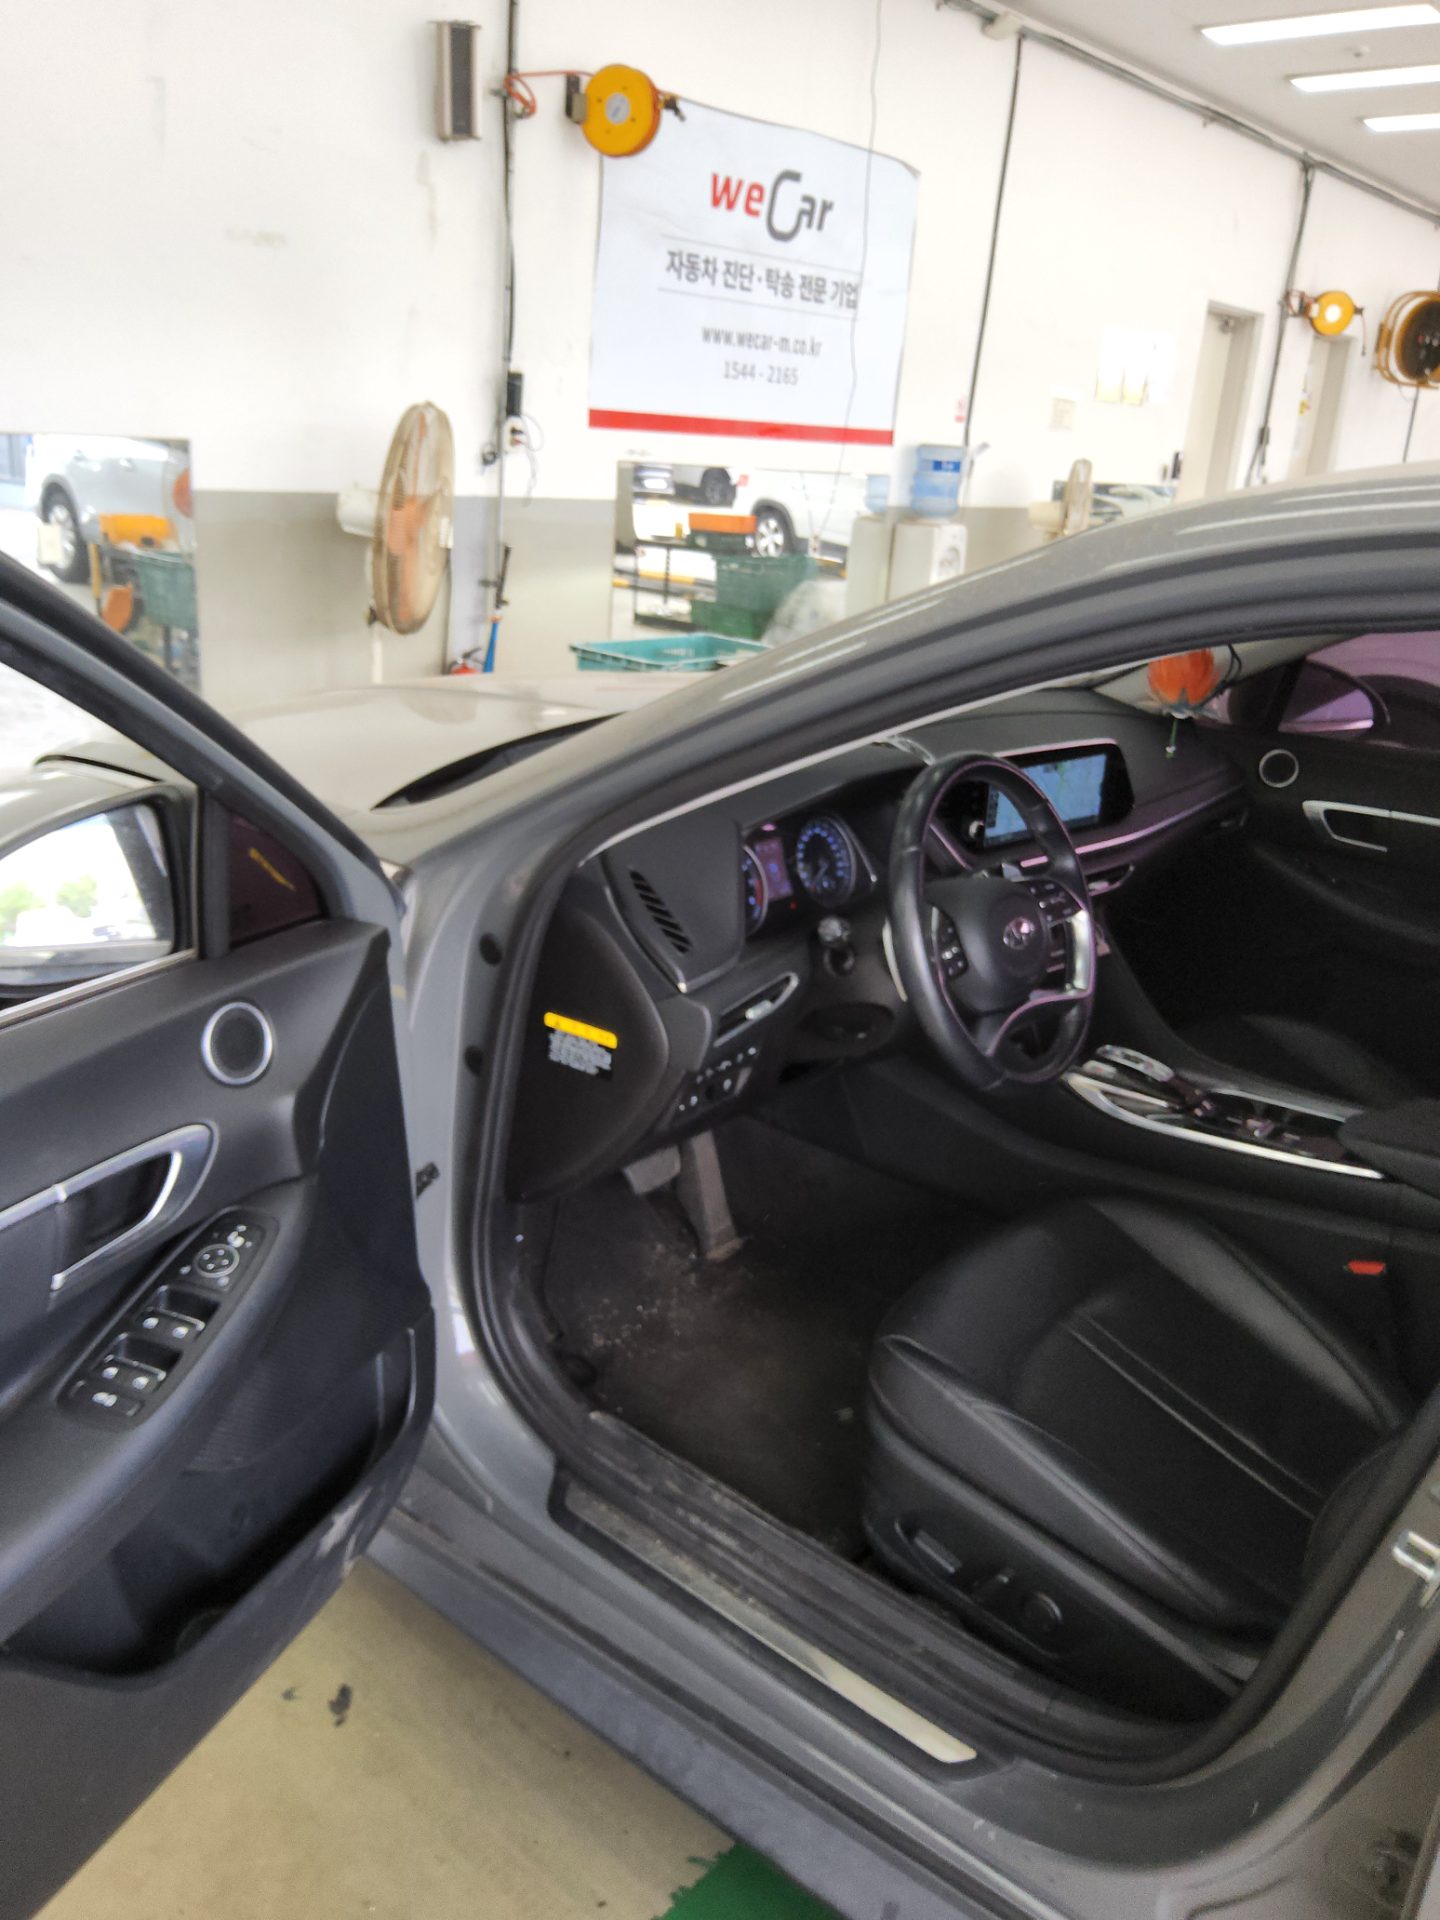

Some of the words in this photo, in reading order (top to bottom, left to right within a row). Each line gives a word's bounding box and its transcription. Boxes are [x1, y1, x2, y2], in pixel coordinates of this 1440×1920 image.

[711, 169, 834, 242] weCar
[666, 249, 719, 287] 자동차
[798, 274, 828, 305] 전문
[830, 280, 860, 310] 기업
[702, 327, 822, 357] www.wecar-m.co.kr
